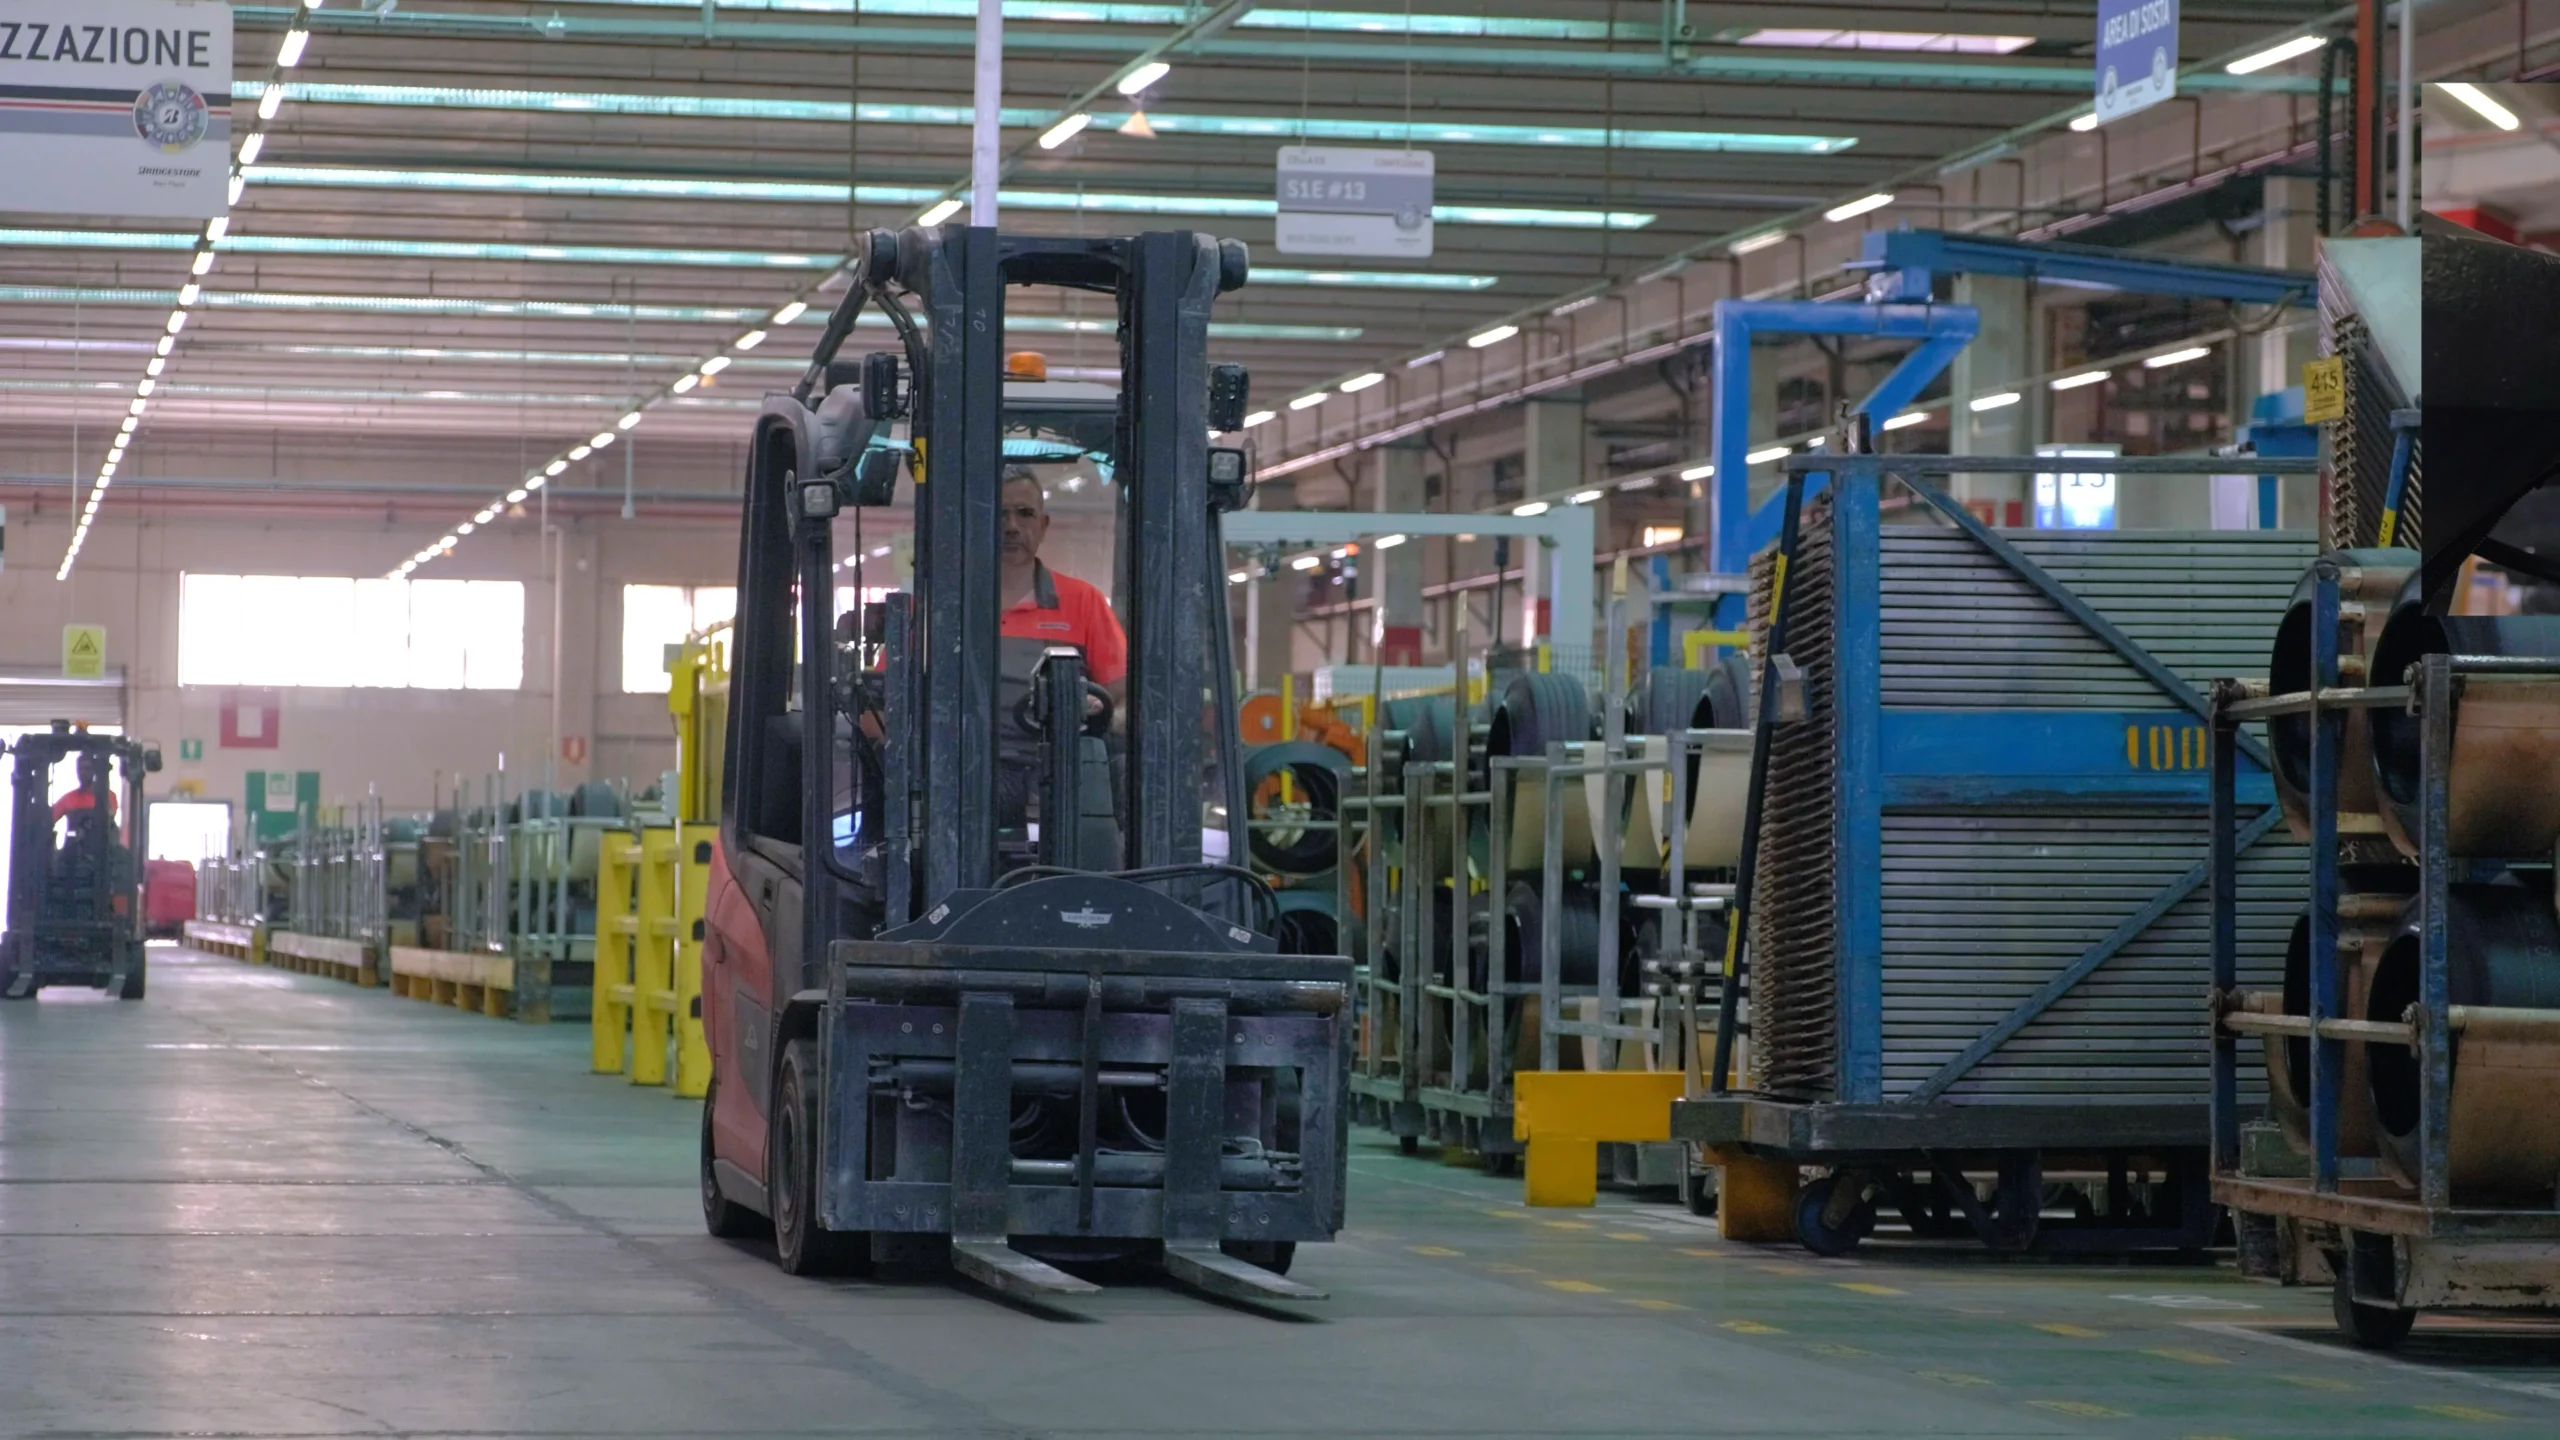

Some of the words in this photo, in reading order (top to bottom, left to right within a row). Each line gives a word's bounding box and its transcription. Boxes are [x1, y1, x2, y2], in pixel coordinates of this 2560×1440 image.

[2103, 13, 2129, 50] AREA
[2129, 7, 2140, 41] DI
[2140, 0, 2170, 35] SOSTA
[0, 22, 210, 67] ZZAZIONE
[1286, 178, 1325, 200] S1E
[2311, 371, 2338, 393] 415
